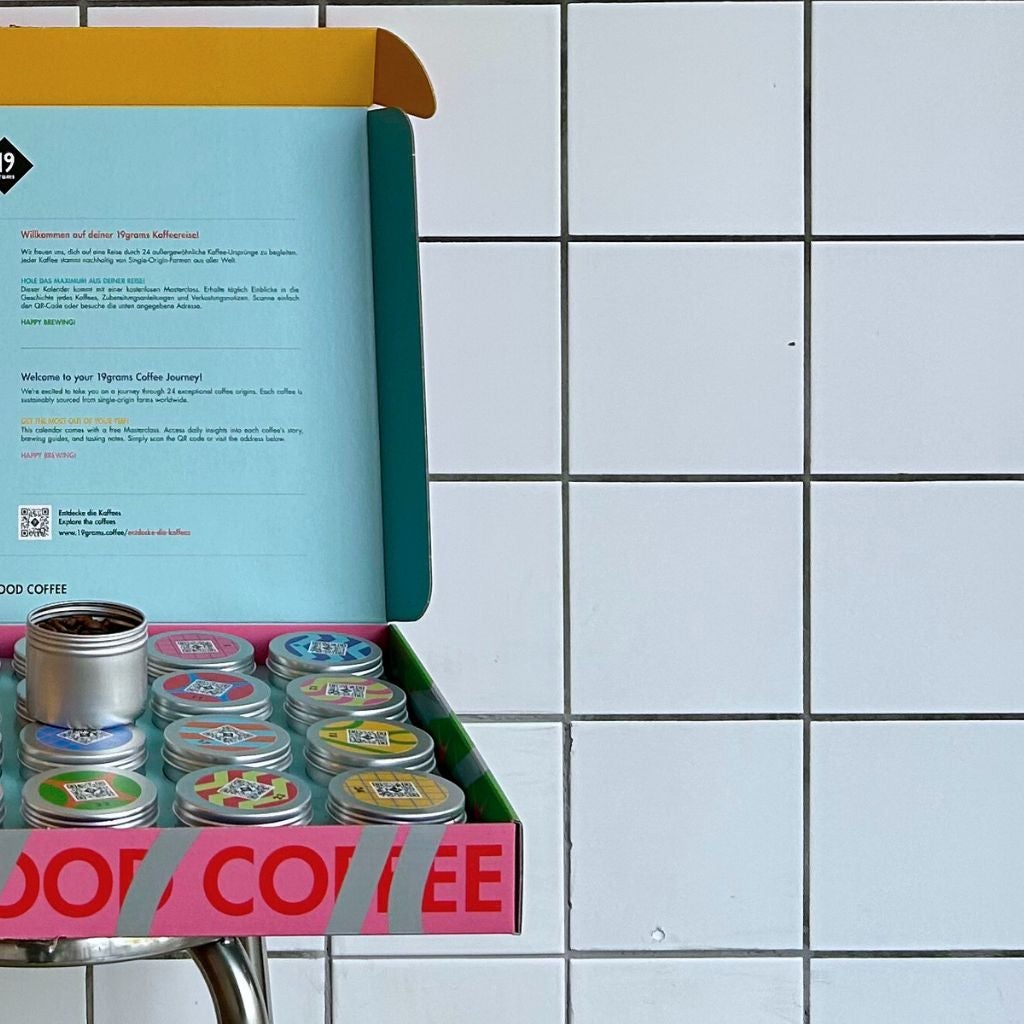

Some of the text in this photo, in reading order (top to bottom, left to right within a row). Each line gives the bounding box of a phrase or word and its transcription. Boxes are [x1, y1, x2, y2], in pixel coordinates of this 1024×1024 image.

[20, 230, 200, 241] Willkommen auf deiner 19grams Kaffeereise!
[21, 372, 202, 384] Welcome to your 19grams Coffee Journey!
[58, 518, 82, 527] Explore
[26, 583, 68, 595] COFFEE
